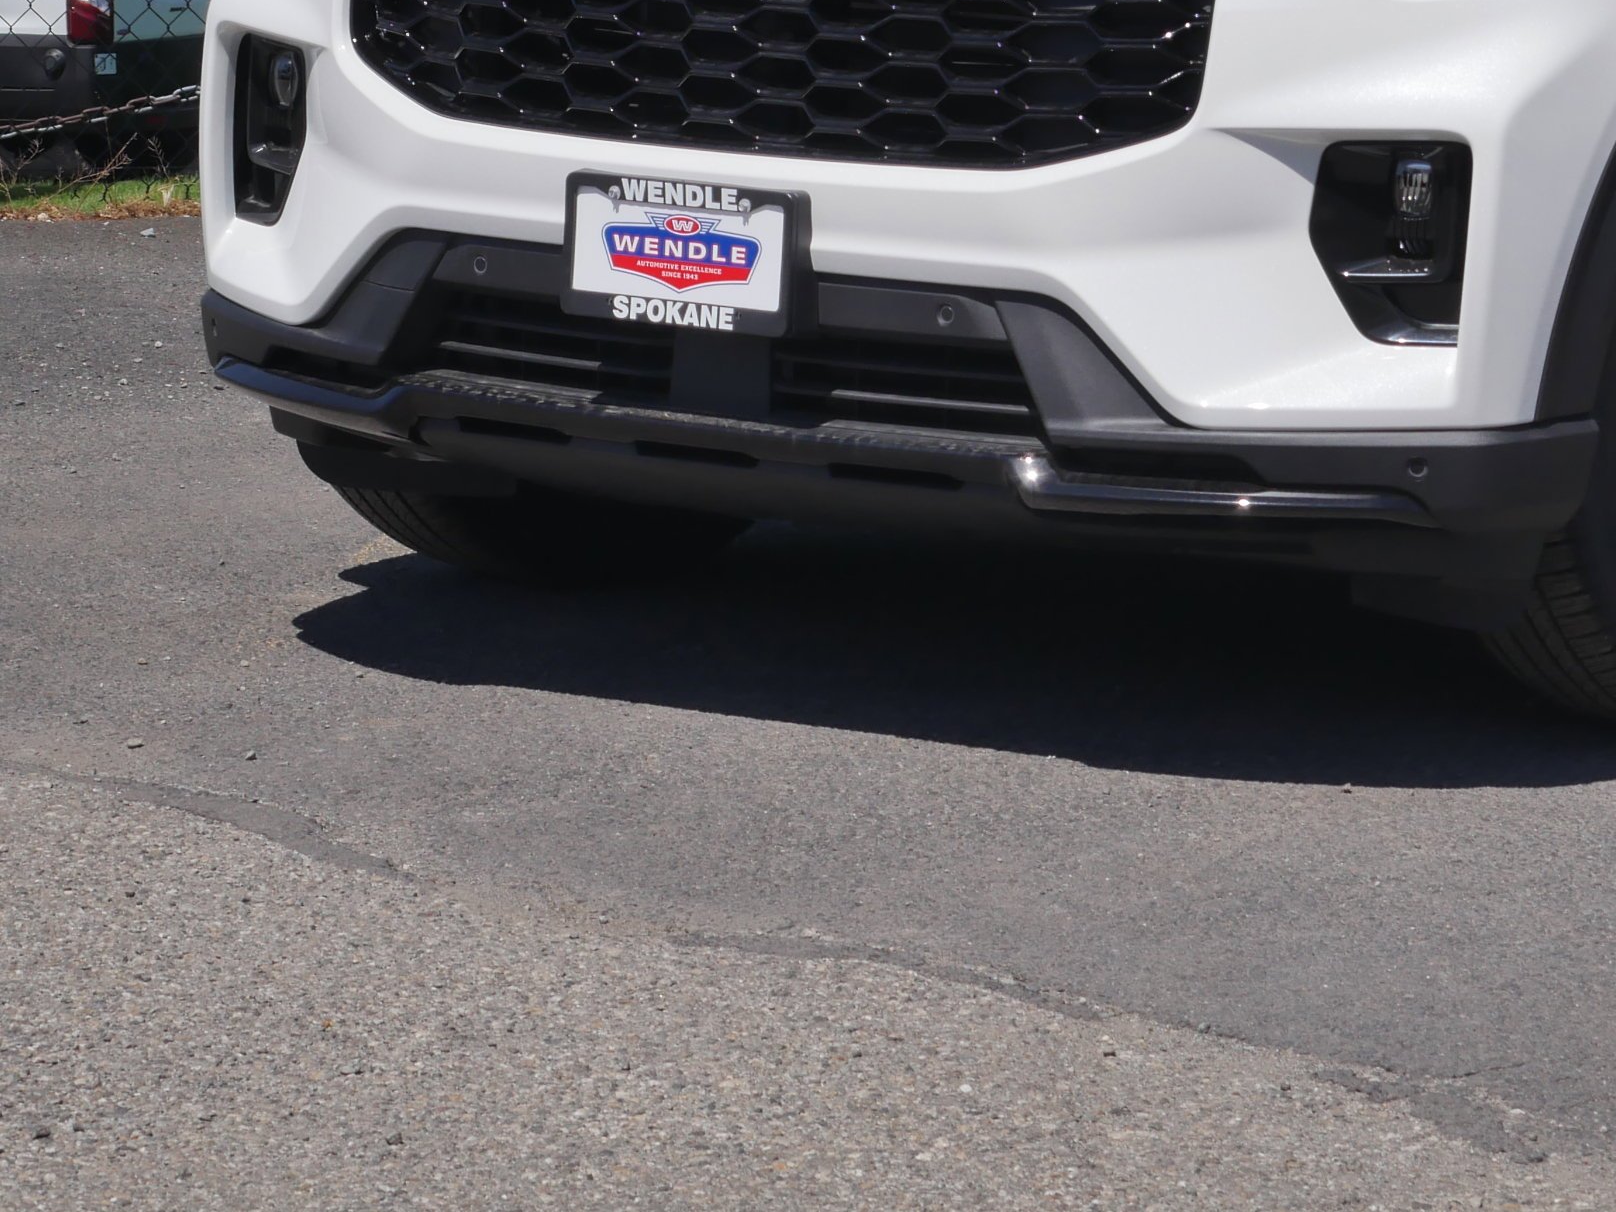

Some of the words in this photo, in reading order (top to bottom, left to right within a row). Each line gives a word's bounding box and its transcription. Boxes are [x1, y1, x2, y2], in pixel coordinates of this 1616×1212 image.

[621, 178, 738, 211] WENDLE
[613, 234, 746, 264] WENDLE
[636, 260, 680, 270] AUTOMOTIVE
[681, 265, 722, 275] EXCELLENCE
[661, 270, 682, 278] SINCE
[612, 295, 735, 331] SPOKANE
